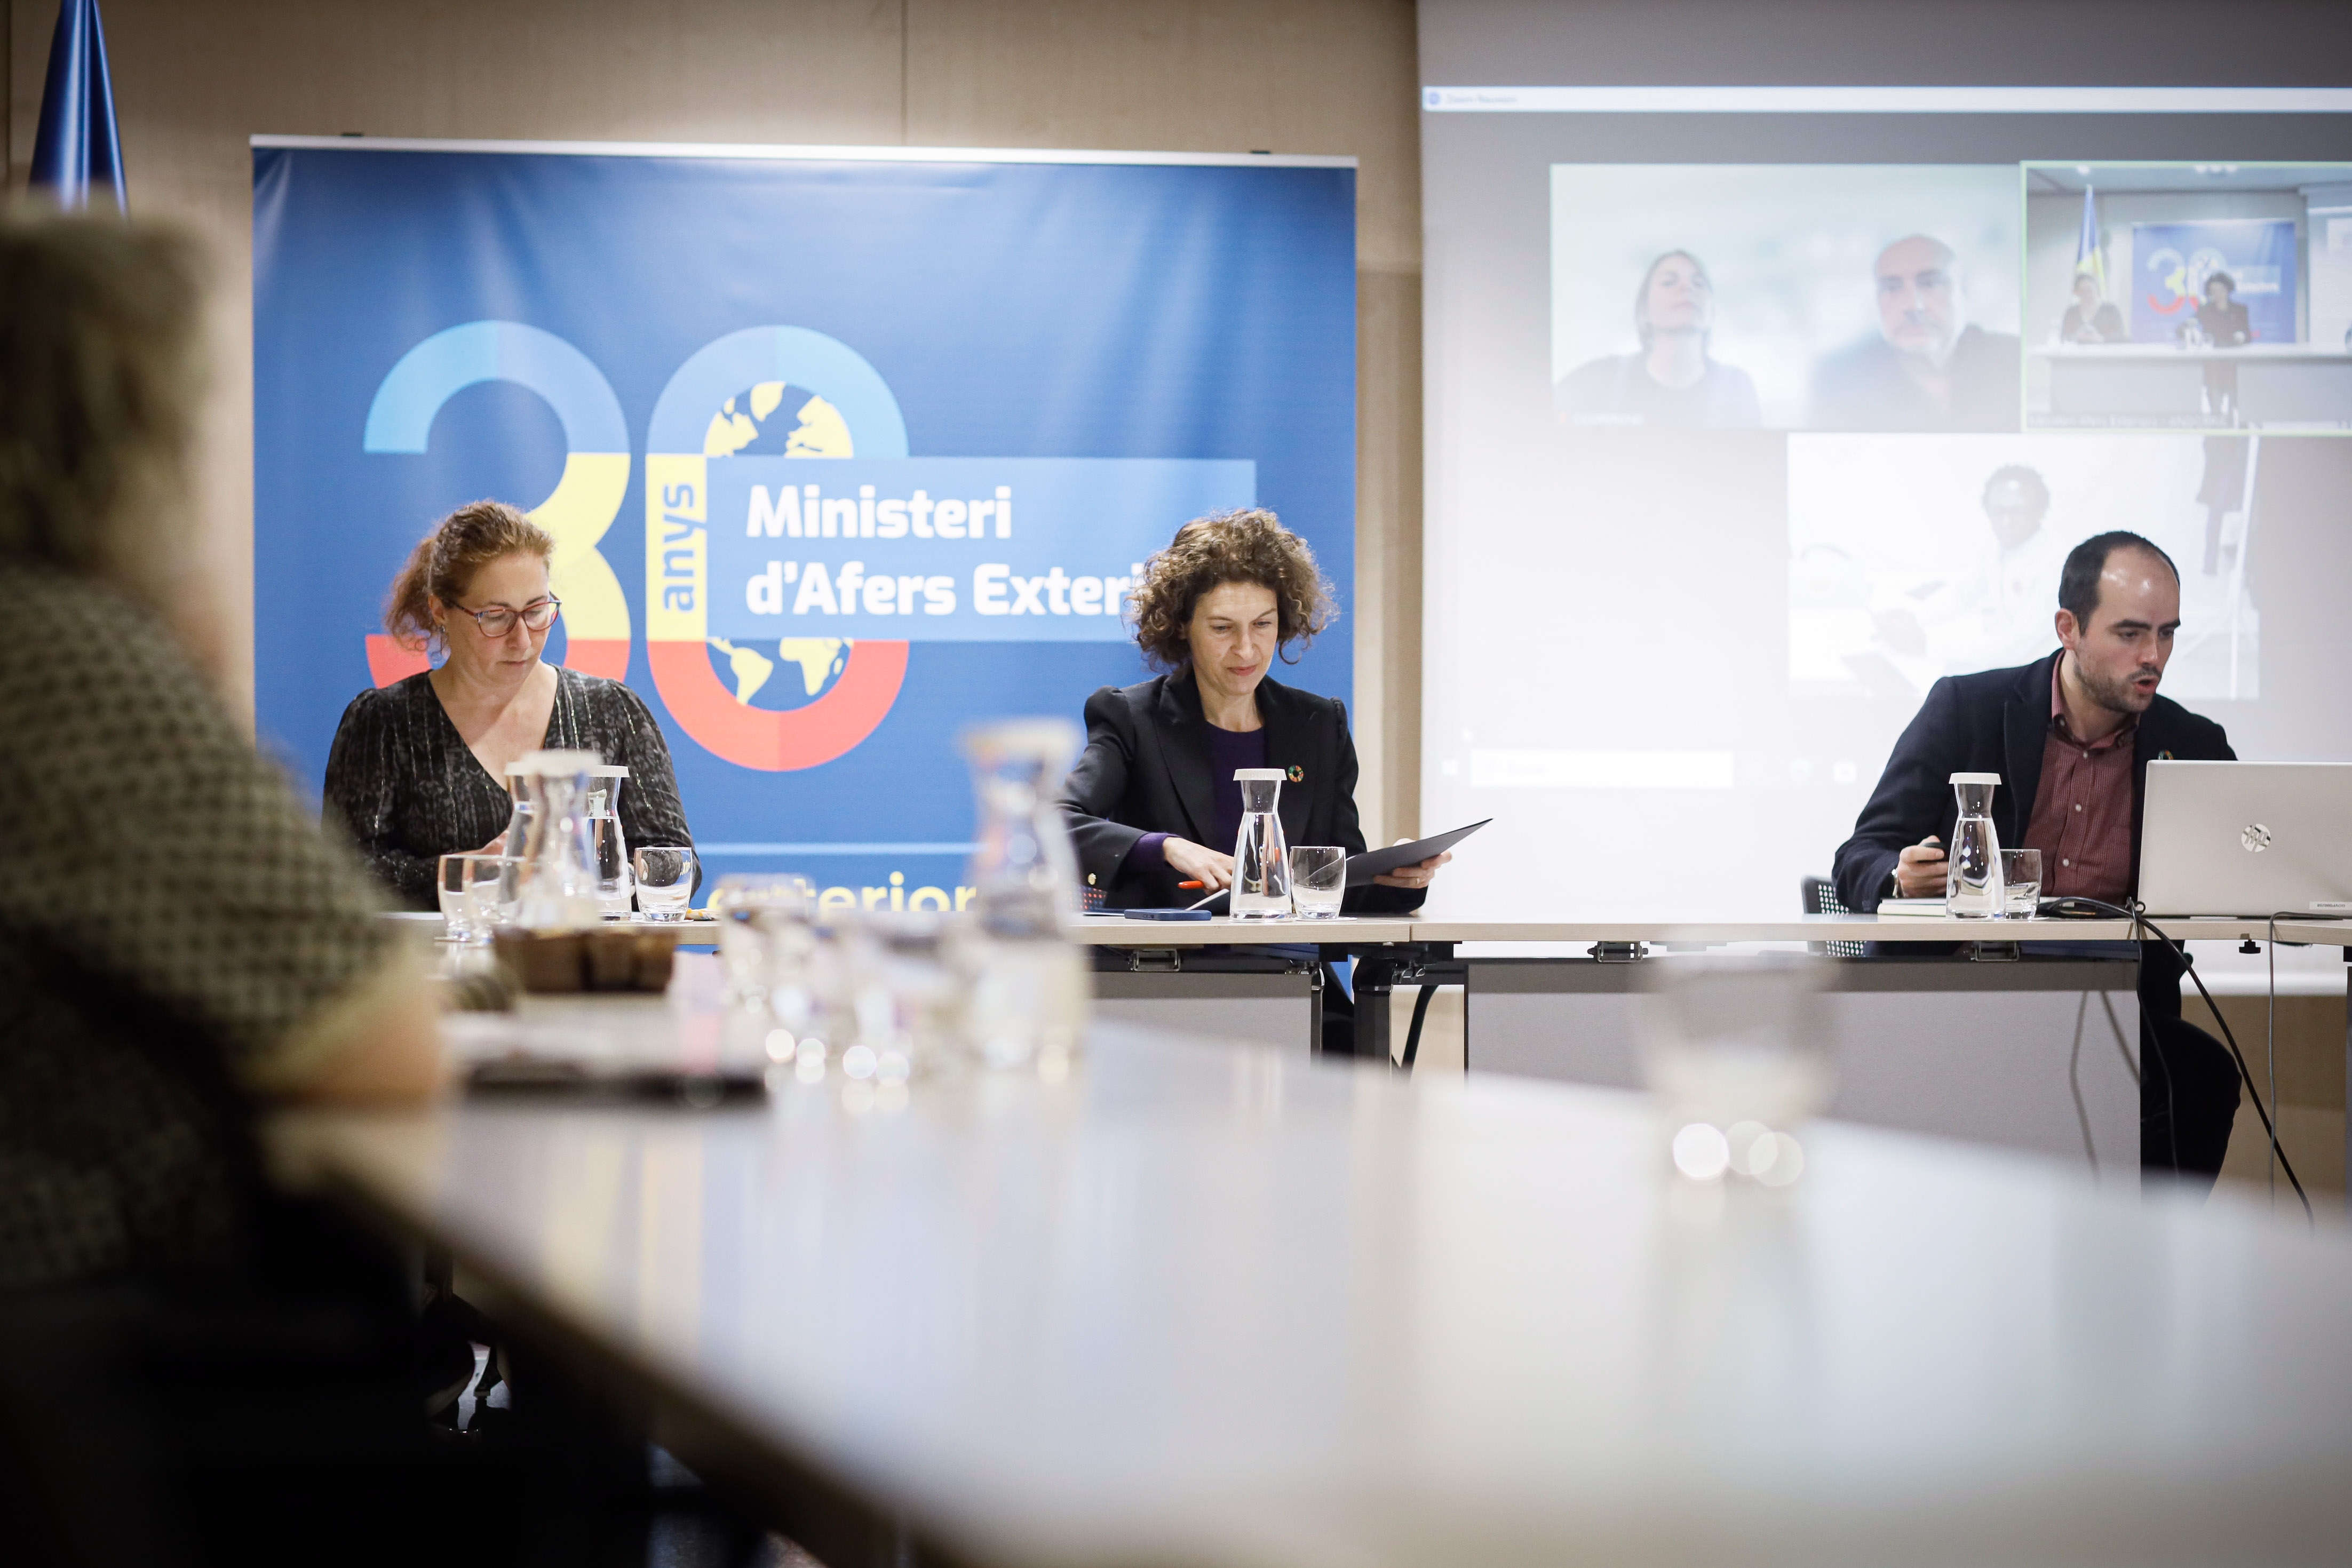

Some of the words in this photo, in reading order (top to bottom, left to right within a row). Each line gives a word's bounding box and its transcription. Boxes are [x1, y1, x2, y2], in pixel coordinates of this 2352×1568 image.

[746, 484, 1012, 539] Ministeri
[364, 320, 909, 772] 30
[663, 484, 706, 611] anys
[746, 560, 957, 616] d'Afers
[2244, 824, 2268, 853] hp
